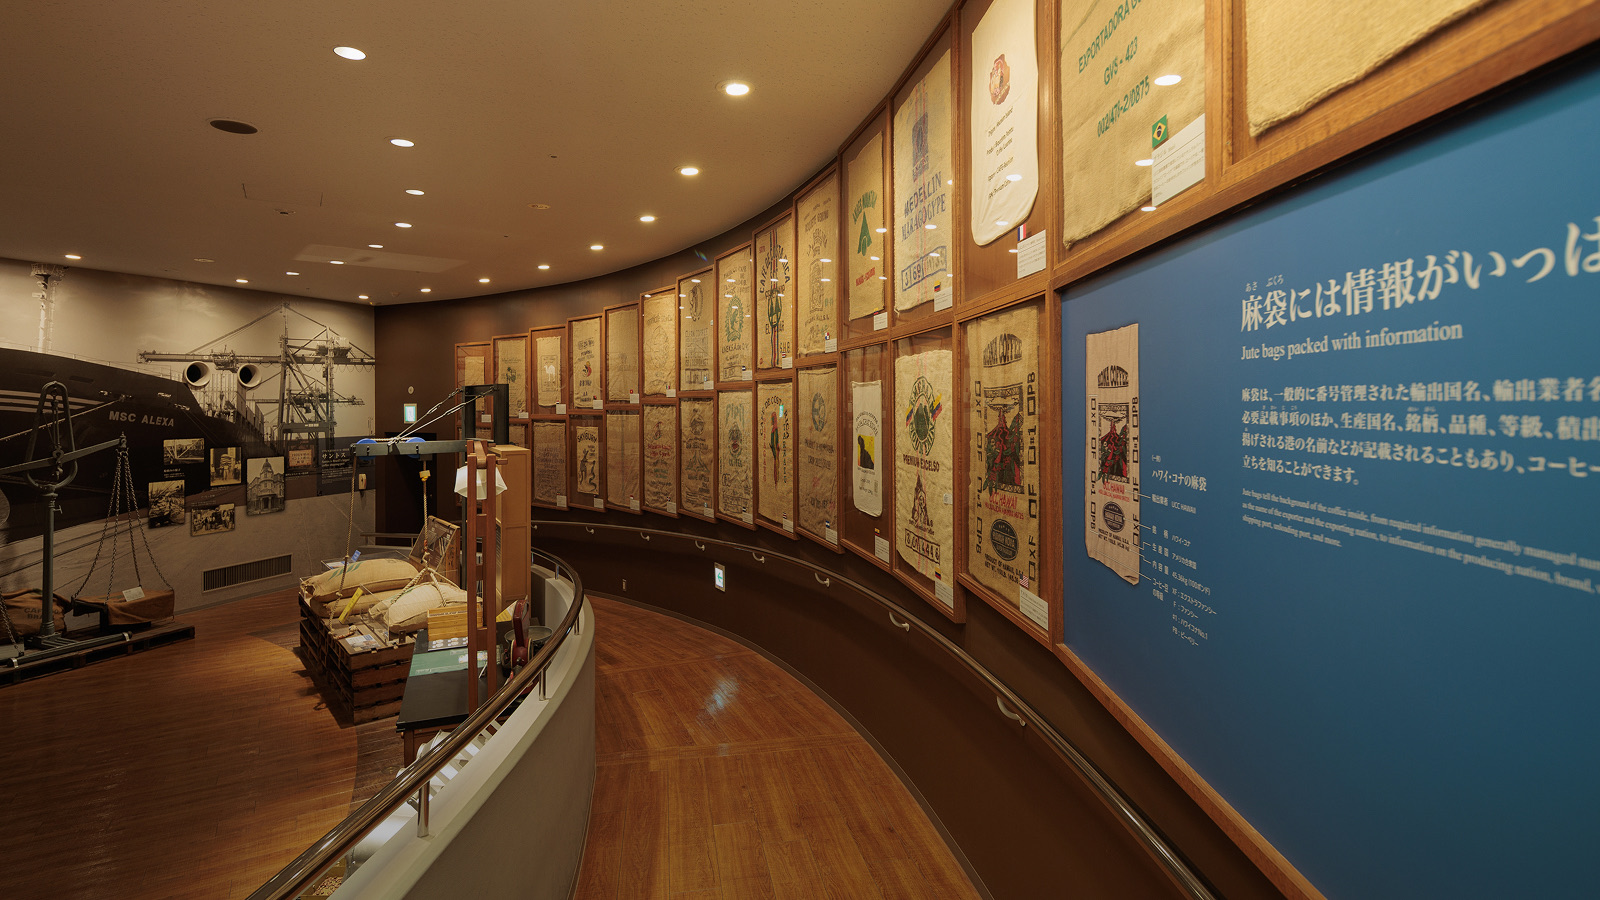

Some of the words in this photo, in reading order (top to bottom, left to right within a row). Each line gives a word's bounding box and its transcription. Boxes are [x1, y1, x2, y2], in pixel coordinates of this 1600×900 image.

[1078, 0, 1130, 74] EXPORTADORA
[1103, 56, 1119, 86] GVS
[1125, 36, 1138, 63] 423
[904, 170, 942, 219] MEDELLIN
[1241, 345, 1260, 361] Jute
[1261, 343, 1285, 361] bags
[1287, 335, 1329, 360] packed
[1331, 330, 1362, 351] with
[1365, 320, 1464, 349] information
[109, 410, 137, 423] MSC
[141, 415, 175, 427] ALEXA
[920, 456, 940, 472] EXCELSO
